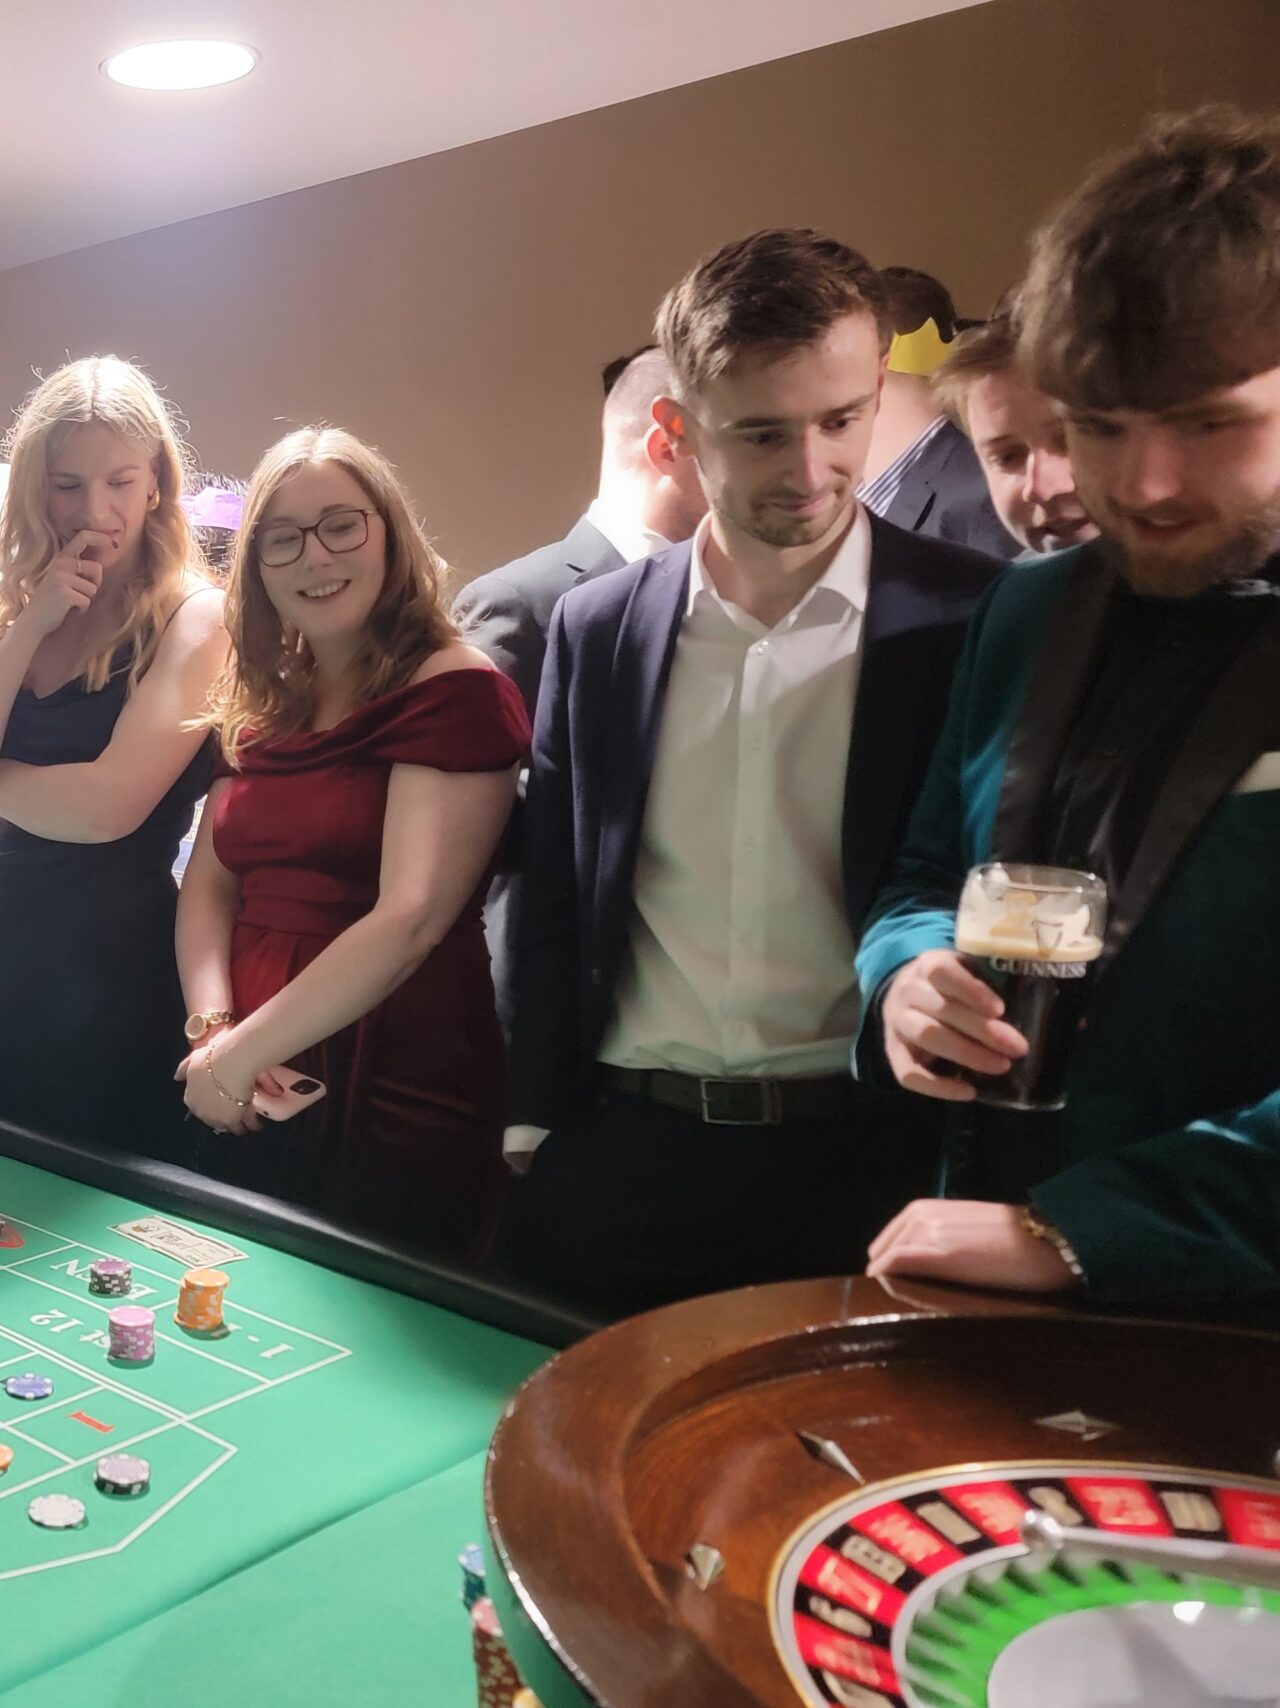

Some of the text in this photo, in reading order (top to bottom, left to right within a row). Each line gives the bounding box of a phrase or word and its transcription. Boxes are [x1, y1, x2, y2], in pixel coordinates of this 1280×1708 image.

[29, 1308, 84, 1333] 12
[260, 1342, 294, 1359] 1
[66, 1410, 115, 1434] 1
